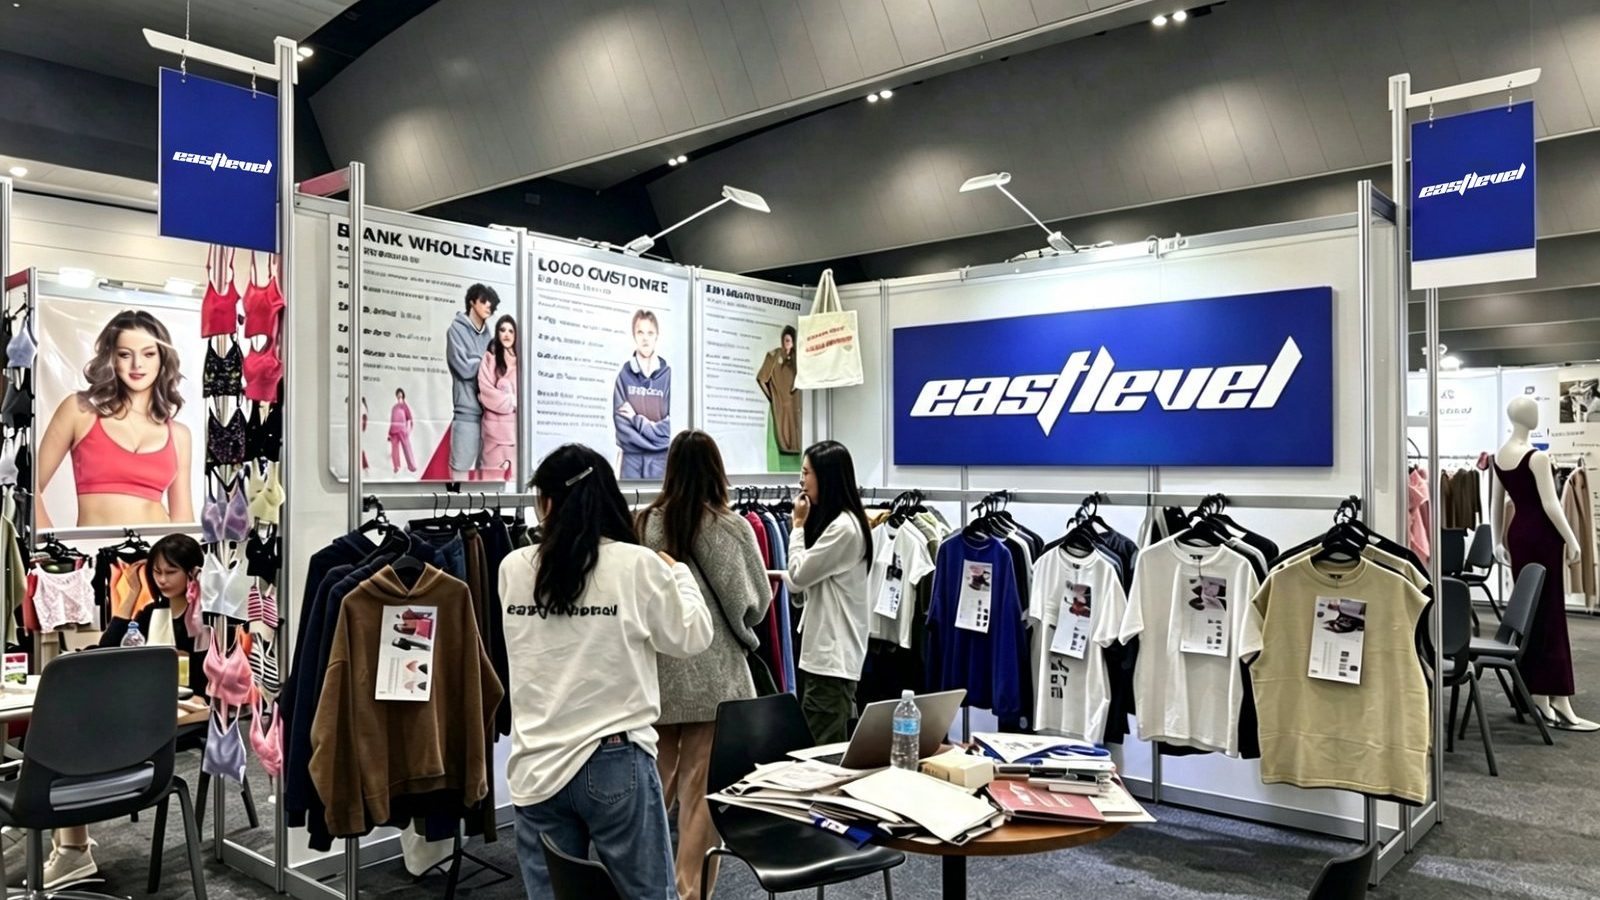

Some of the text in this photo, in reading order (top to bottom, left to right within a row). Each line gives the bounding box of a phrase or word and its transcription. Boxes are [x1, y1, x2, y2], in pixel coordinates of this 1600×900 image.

[172, 151, 273, 175] eastlevel
[1418, 163, 1526, 198] eastlevel
[337, 222, 404, 248] BANK
[910, 336, 1303, 437] eastlevel
